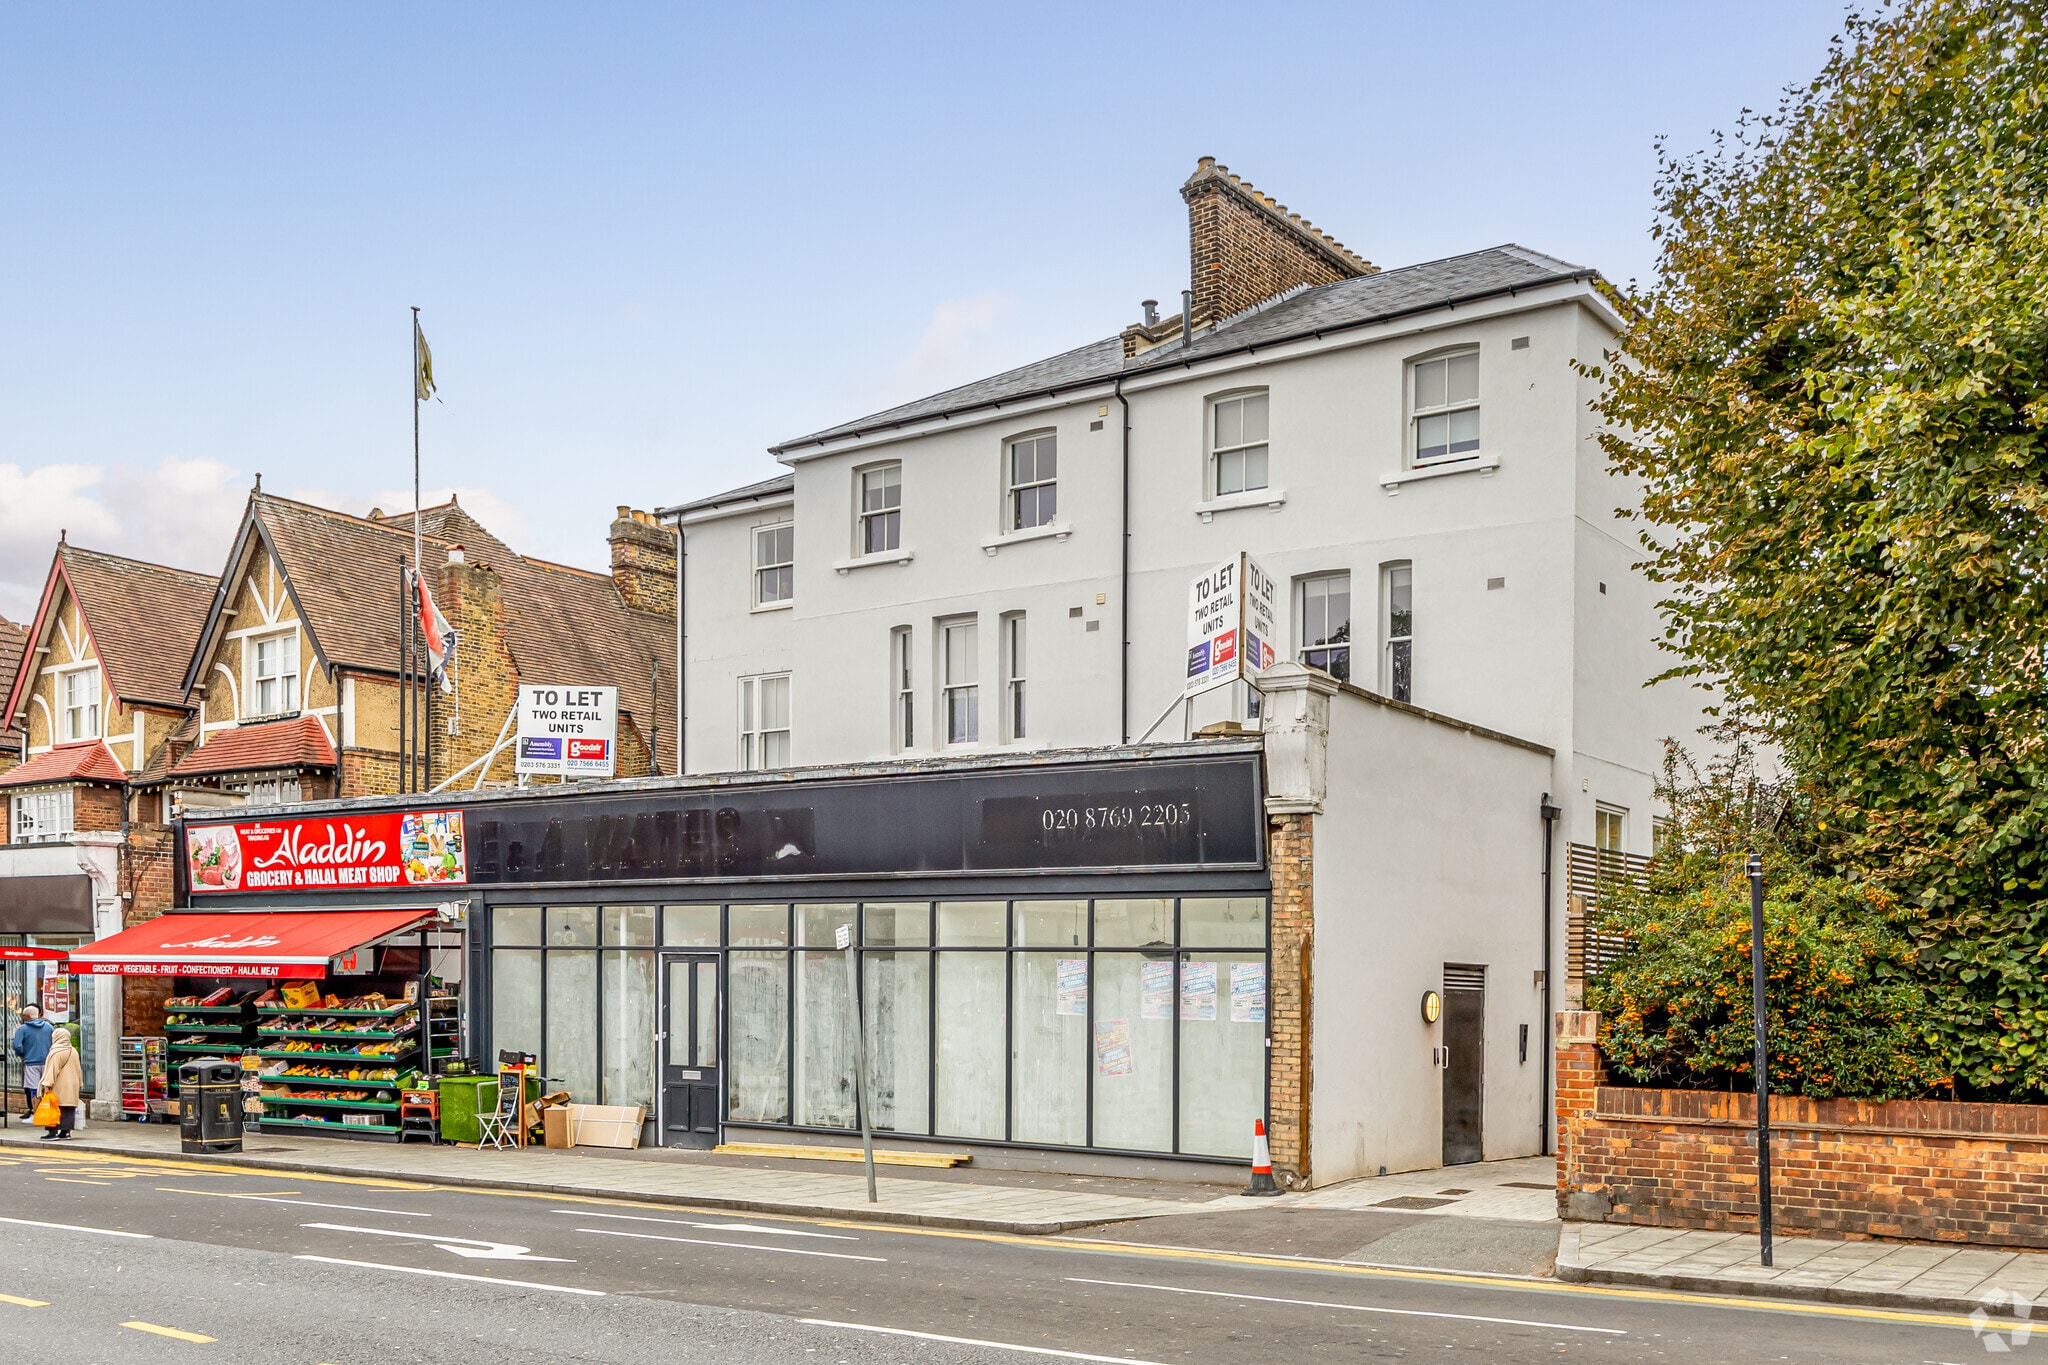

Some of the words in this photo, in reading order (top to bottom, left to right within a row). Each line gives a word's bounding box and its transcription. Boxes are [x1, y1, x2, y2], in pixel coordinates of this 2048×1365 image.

[1196, 578, 1209, 602] TO
[1214, 563, 1234, 594] LET
[1250, 563, 1259, 591] TO
[1261, 575, 1273, 604] LET
[1195, 605, 1208, 622] TWO
[1210, 593, 1233, 614] RETAIL
[1203, 615, 1223, 635] UNITS
[533, 690, 558, 705] TO
[566, 691, 602, 706] LET
[532, 711, 556, 719] TWO
[561, 711, 601, 720] RETAIL
[549, 724, 583, 733] UNITS
[1042, 808, 1077, 830] 020
[1085, 807, 1133, 828] 8769
[1140, 803, 1190, 826] 2205
[254, 824, 386, 868] Aladdin
[247, 870, 293, 887] GROCERY
[295, 872, 303, 885] &
[304, 868, 337, 884] HALAL
[338, 867, 367, 884] MEAT
[369, 866, 400, 882] SHOP
[93, 964, 120, 973] GROCERY
[123, 965, 156, 973] VEGETABLE
[161, 965, 178, 973] FRUIT
[182, 965, 234, 974] CONFECTIONERY
[238, 966, 260, 975] HALAL
[261, 967, 279, 975] MEAT
